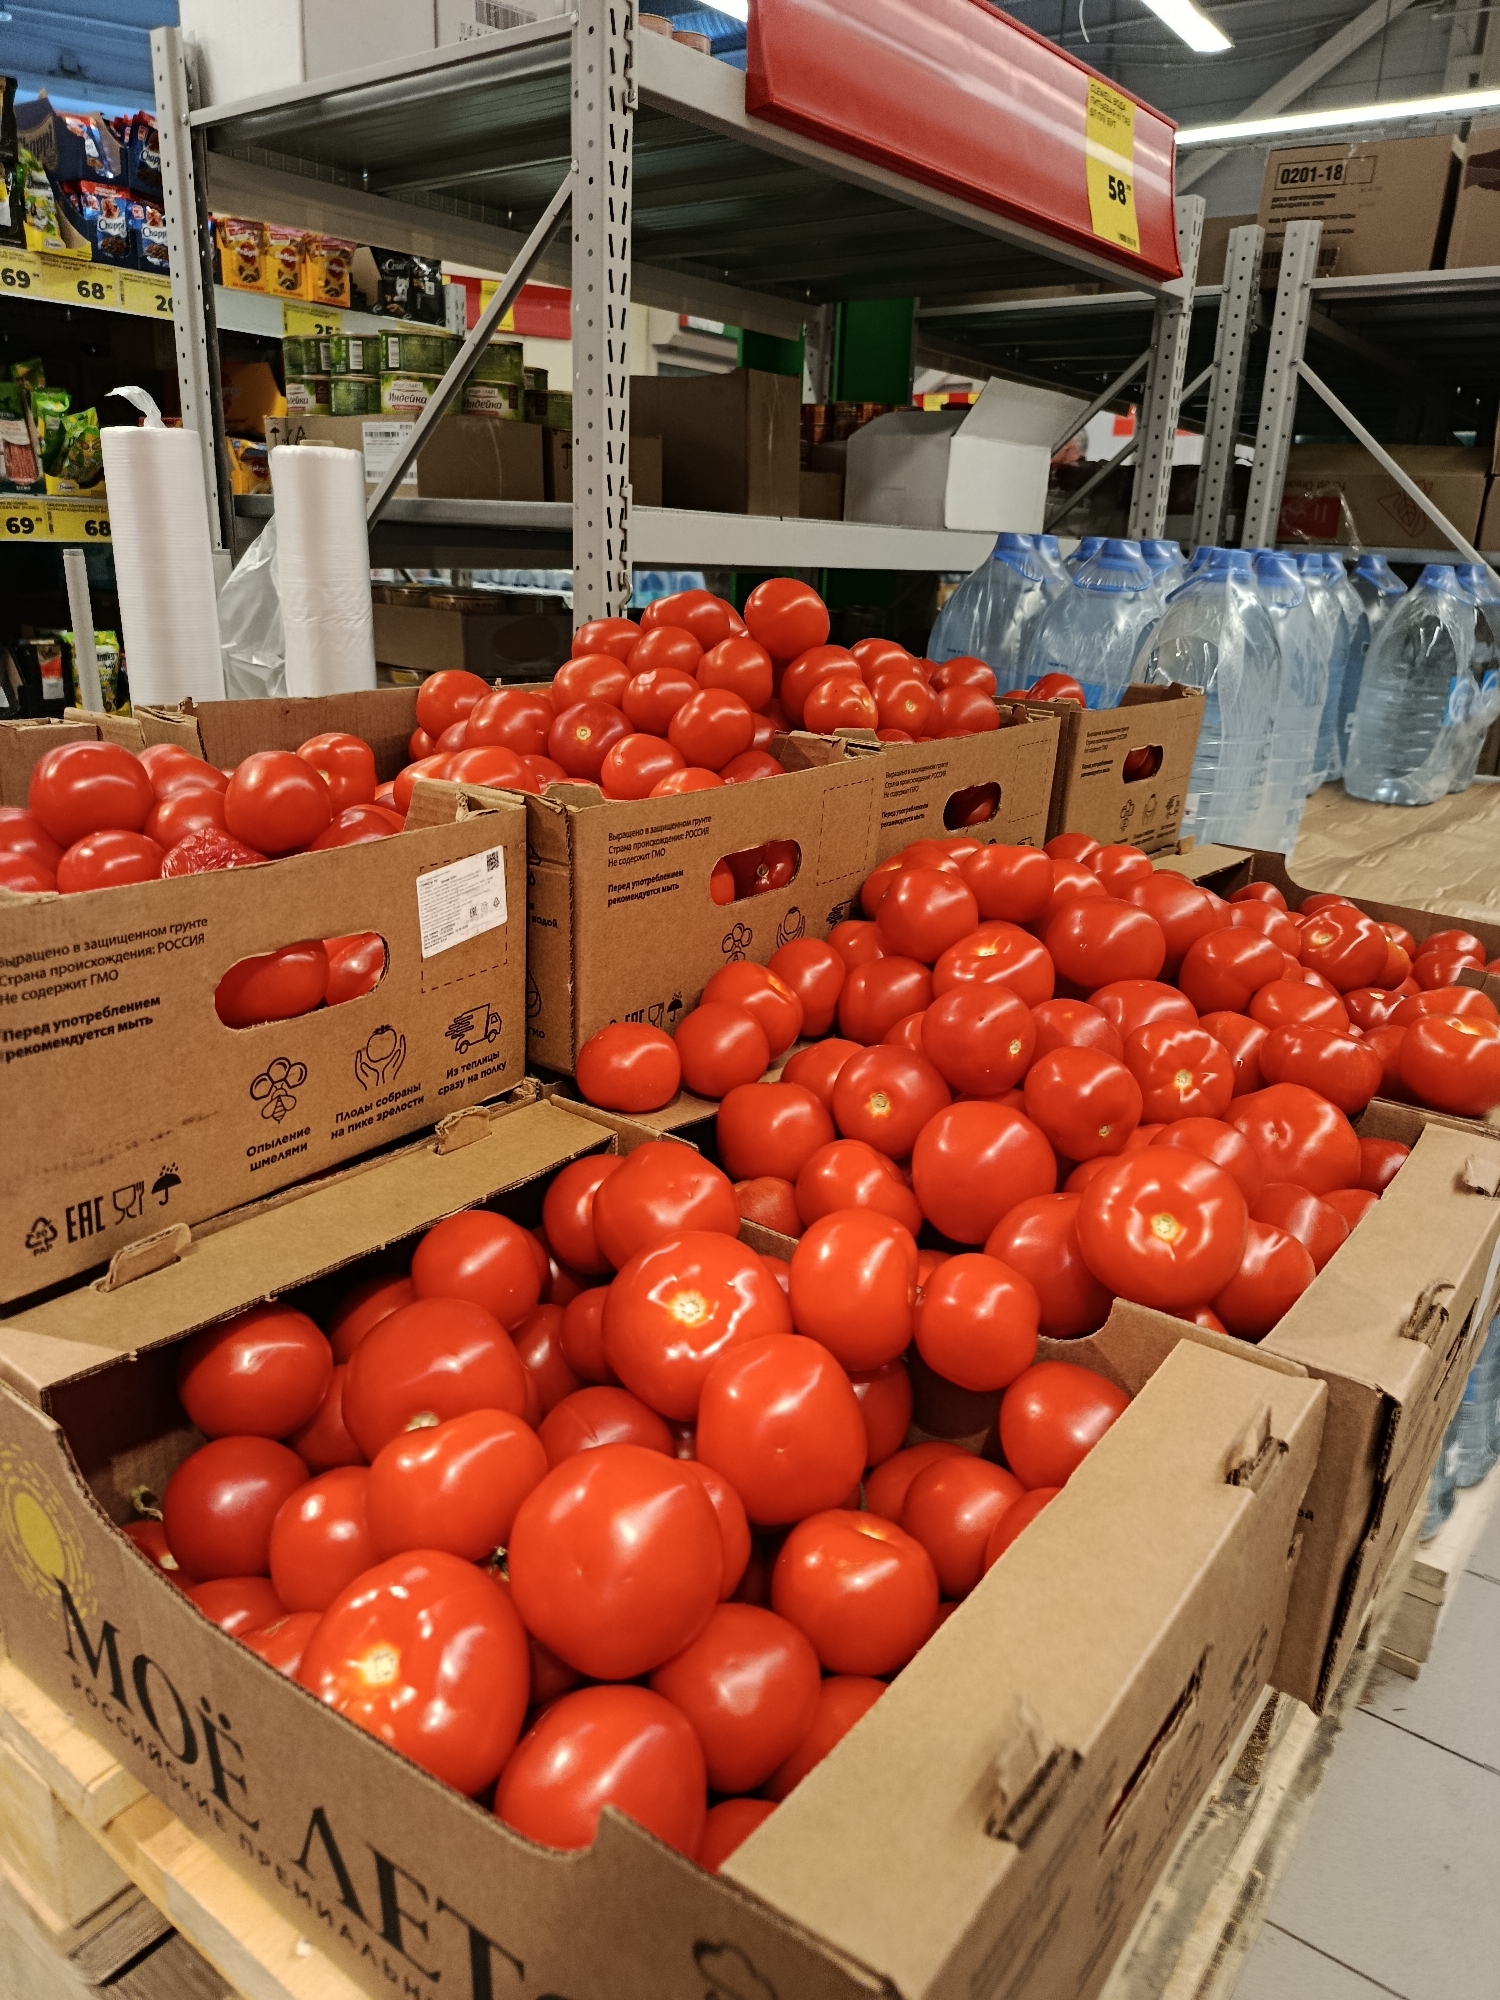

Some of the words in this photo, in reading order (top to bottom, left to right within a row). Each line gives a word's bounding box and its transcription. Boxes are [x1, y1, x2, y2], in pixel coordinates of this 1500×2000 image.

[1279, 164, 1343, 185] 0201-18
[1109, 174, 1126, 206] 58
[1, 268, 30, 289] 69
[77, 280, 105, 300] 68
[389, 392, 428, 405] Индейка
[6, 516, 35, 535] 69
[84, 520, 111, 537] 68
[608, 843, 632, 856] Страна
[633, 834, 685, 852] происхождения:
[685, 827, 710, 840] РОССИЯ
[609, 828, 645, 843] Выращено
[650, 819, 691, 834] защищенном
[692, 815, 712, 827] грунте
[608, 859, 618, 867] Не
[618, 852, 650, 867] содержит
[651, 847, 666, 859] ГМО
[607, 887, 661, 908] рекомендуется
[661, 883, 680, 894] мыть
[608, 882, 631, 893] Перед
[631, 869, 684, 890] употреблением
[531, 915, 558, 929] водой
[0, 945, 70, 969] Выращено
[73, 943, 81, 953] в
[83, 926, 167, 952] защищенном
[169, 918, 208, 936] грунте
[0, 969, 47, 989] Страна
[50, 946, 156, 978] происхождения:
[157, 933, 205, 954] РОССИЯ
[0, 993, 18, 1006] Не
[21, 977, 88, 1003] содержит
[90, 969, 119, 986] ГМО
[3, 1023, 50, 1043] Перед
[53, 996, 161, 1034] употреблением
[5, 1025, 115, 1064] рекомендуется
[117, 1016, 154, 1034] мыть
[437, 1079, 465, 1097] сразу
[467, 1072, 479, 1085] на
[480, 1061, 508, 1080] полку
[446, 1065, 459, 1080] Из
[461, 1051, 501, 1073] теплицы
[335, 1103, 374, 1124] Плоды
[375, 1082, 422, 1108] собраны
[330, 1127, 345, 1141] на
[347, 1116, 374, 1134] пике
[376, 1095, 425, 1123] зрелости
[246, 1125, 312, 1157] Опыление
[250, 1142, 309, 1172] шмелями
[32, 1242, 54, 1257] PAP
[52, 1572, 261, 1833] МОЁ
[293, 1805, 576, 2000] ЛЕТ
[70, 1673, 227, 1834] РОССИЙСКИЕ
[239, 1831, 433, 2000] ПРЕМИАЛЬН
